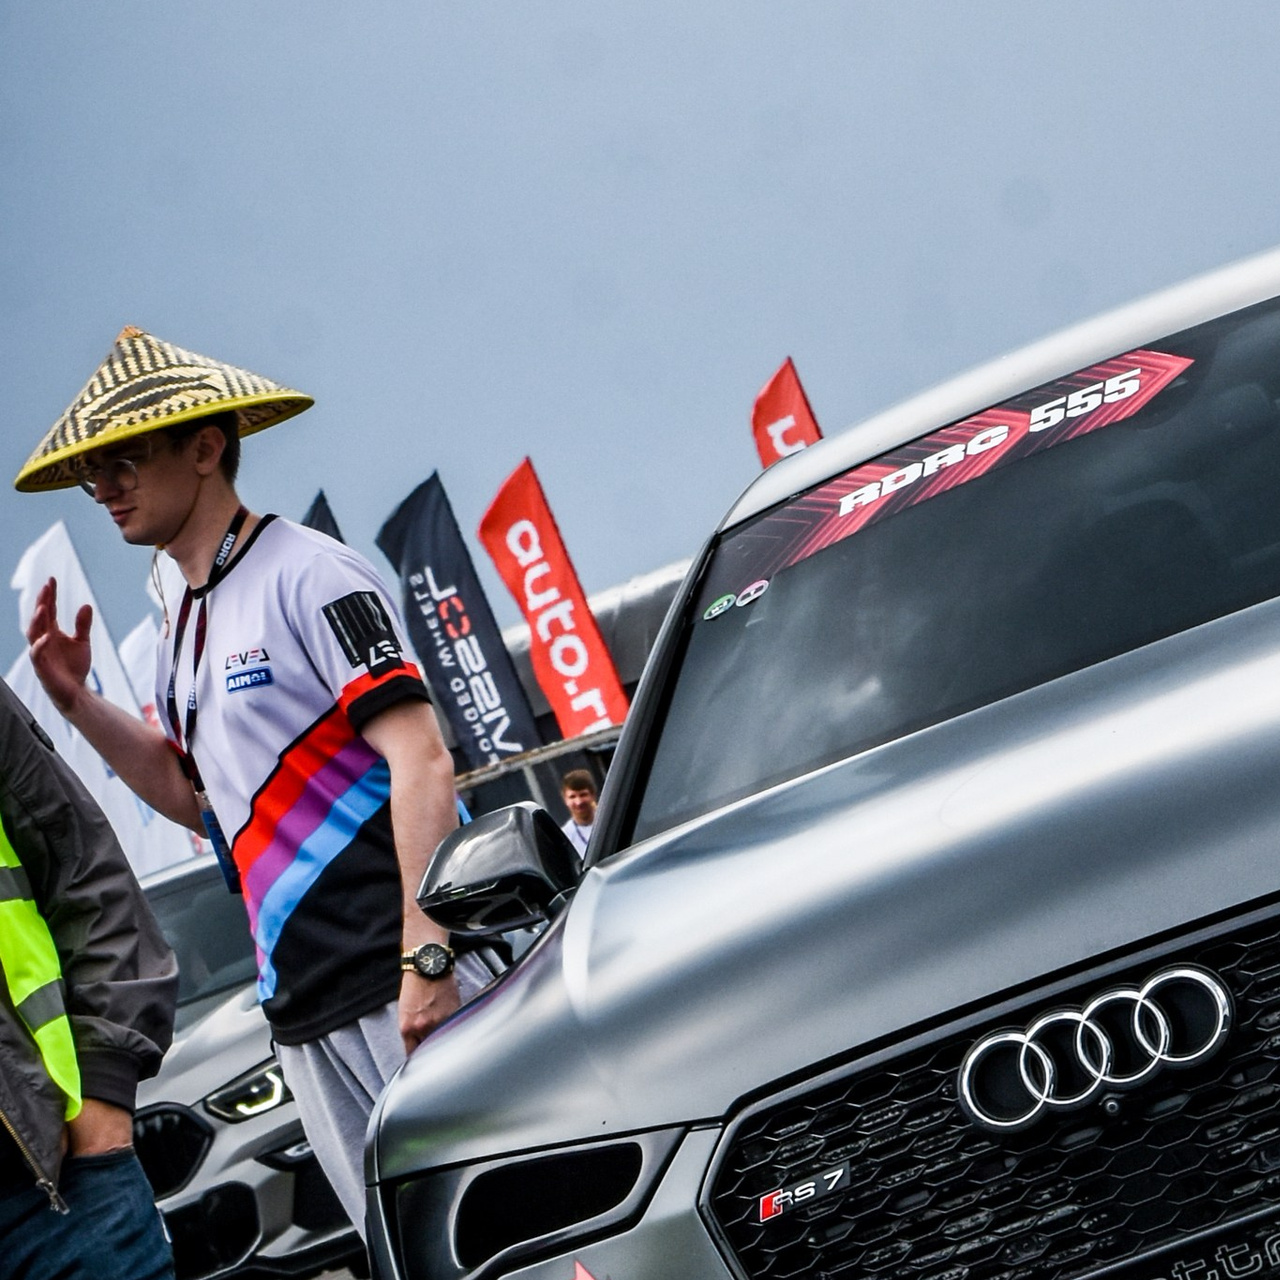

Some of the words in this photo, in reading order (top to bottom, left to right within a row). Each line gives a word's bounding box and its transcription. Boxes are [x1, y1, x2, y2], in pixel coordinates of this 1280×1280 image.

[838, 424, 1010, 518] RDRC
[1028, 367, 1142, 433] 555
[822, 1167, 845, 1192] 7
